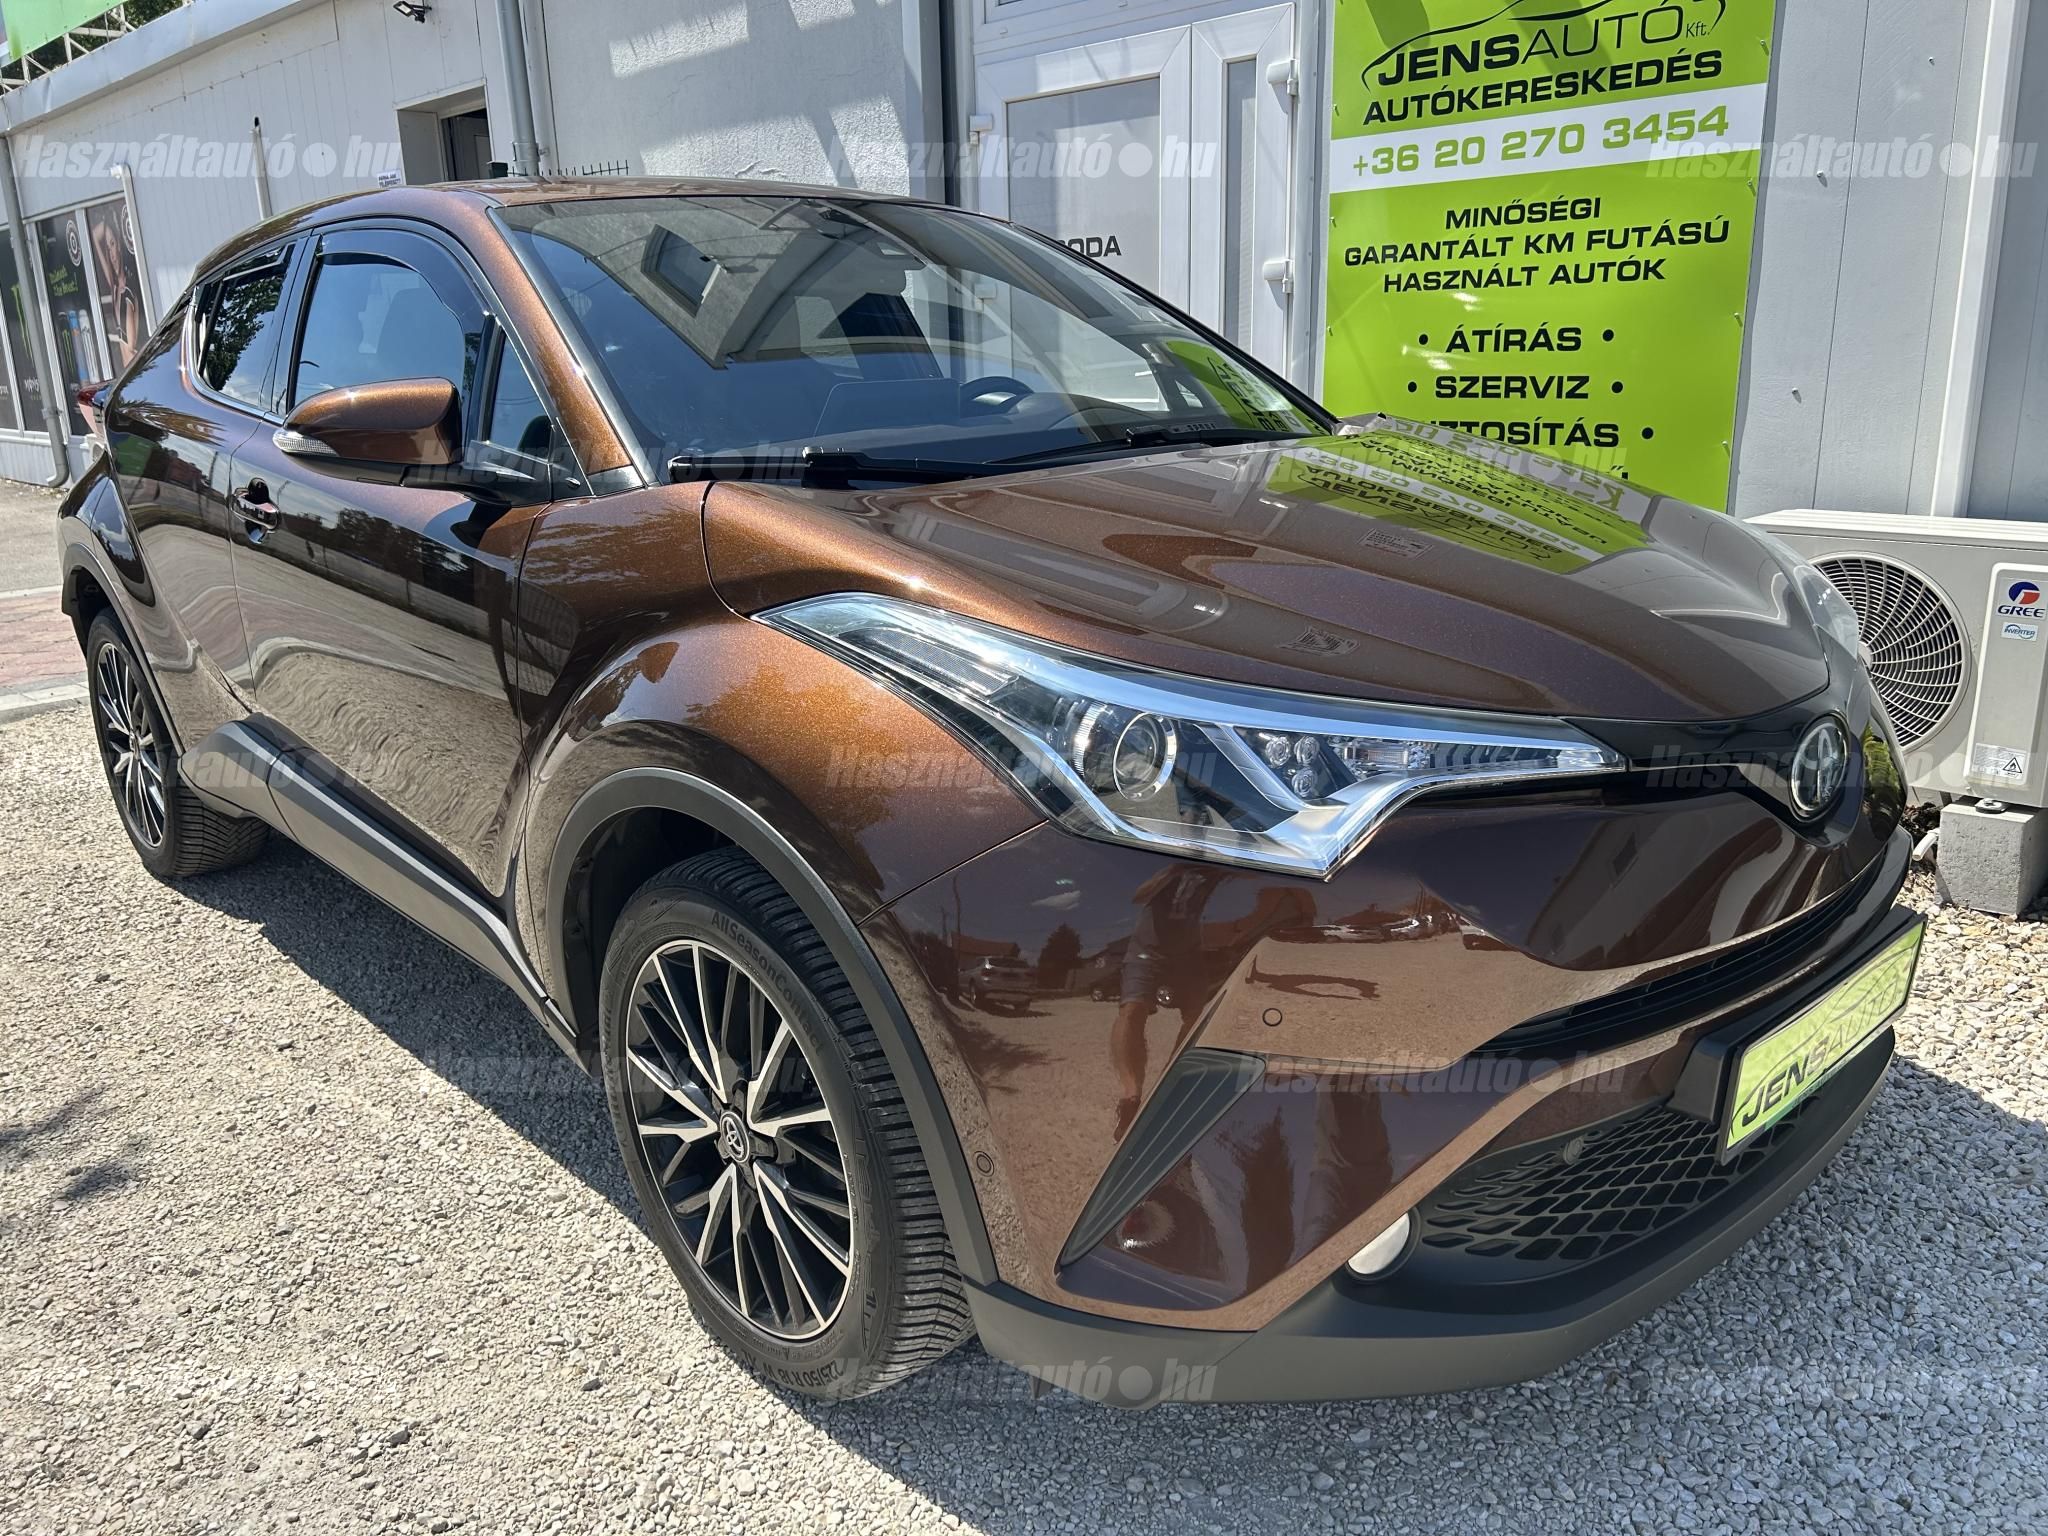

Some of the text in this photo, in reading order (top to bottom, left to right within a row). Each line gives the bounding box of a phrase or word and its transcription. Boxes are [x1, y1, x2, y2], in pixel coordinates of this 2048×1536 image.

[1685, 21, 1711, 40] Kft.
[1363, 49, 1723, 125] AUTÓKERESKEDÉS
[1353, 105, 1729, 176] +36 20 270 3454
[1446, 198, 1601, 229] MINŐSÉGI
[1057, 235, 1122, 258] ODA
[1345, 215, 1730, 267] GARANTÁLT KM FUTÁSÚ
[1384, 257, 1666, 293] HASZNÁLT AUTÓK
[1445, 321, 1582, 353] ÁTÍRÁS
[1435, 375, 1590, 400] SZERVIZ
[1431, 417, 1619, 447] TOSÍTÁS
[1997, 604, 2046, 618] GREE
